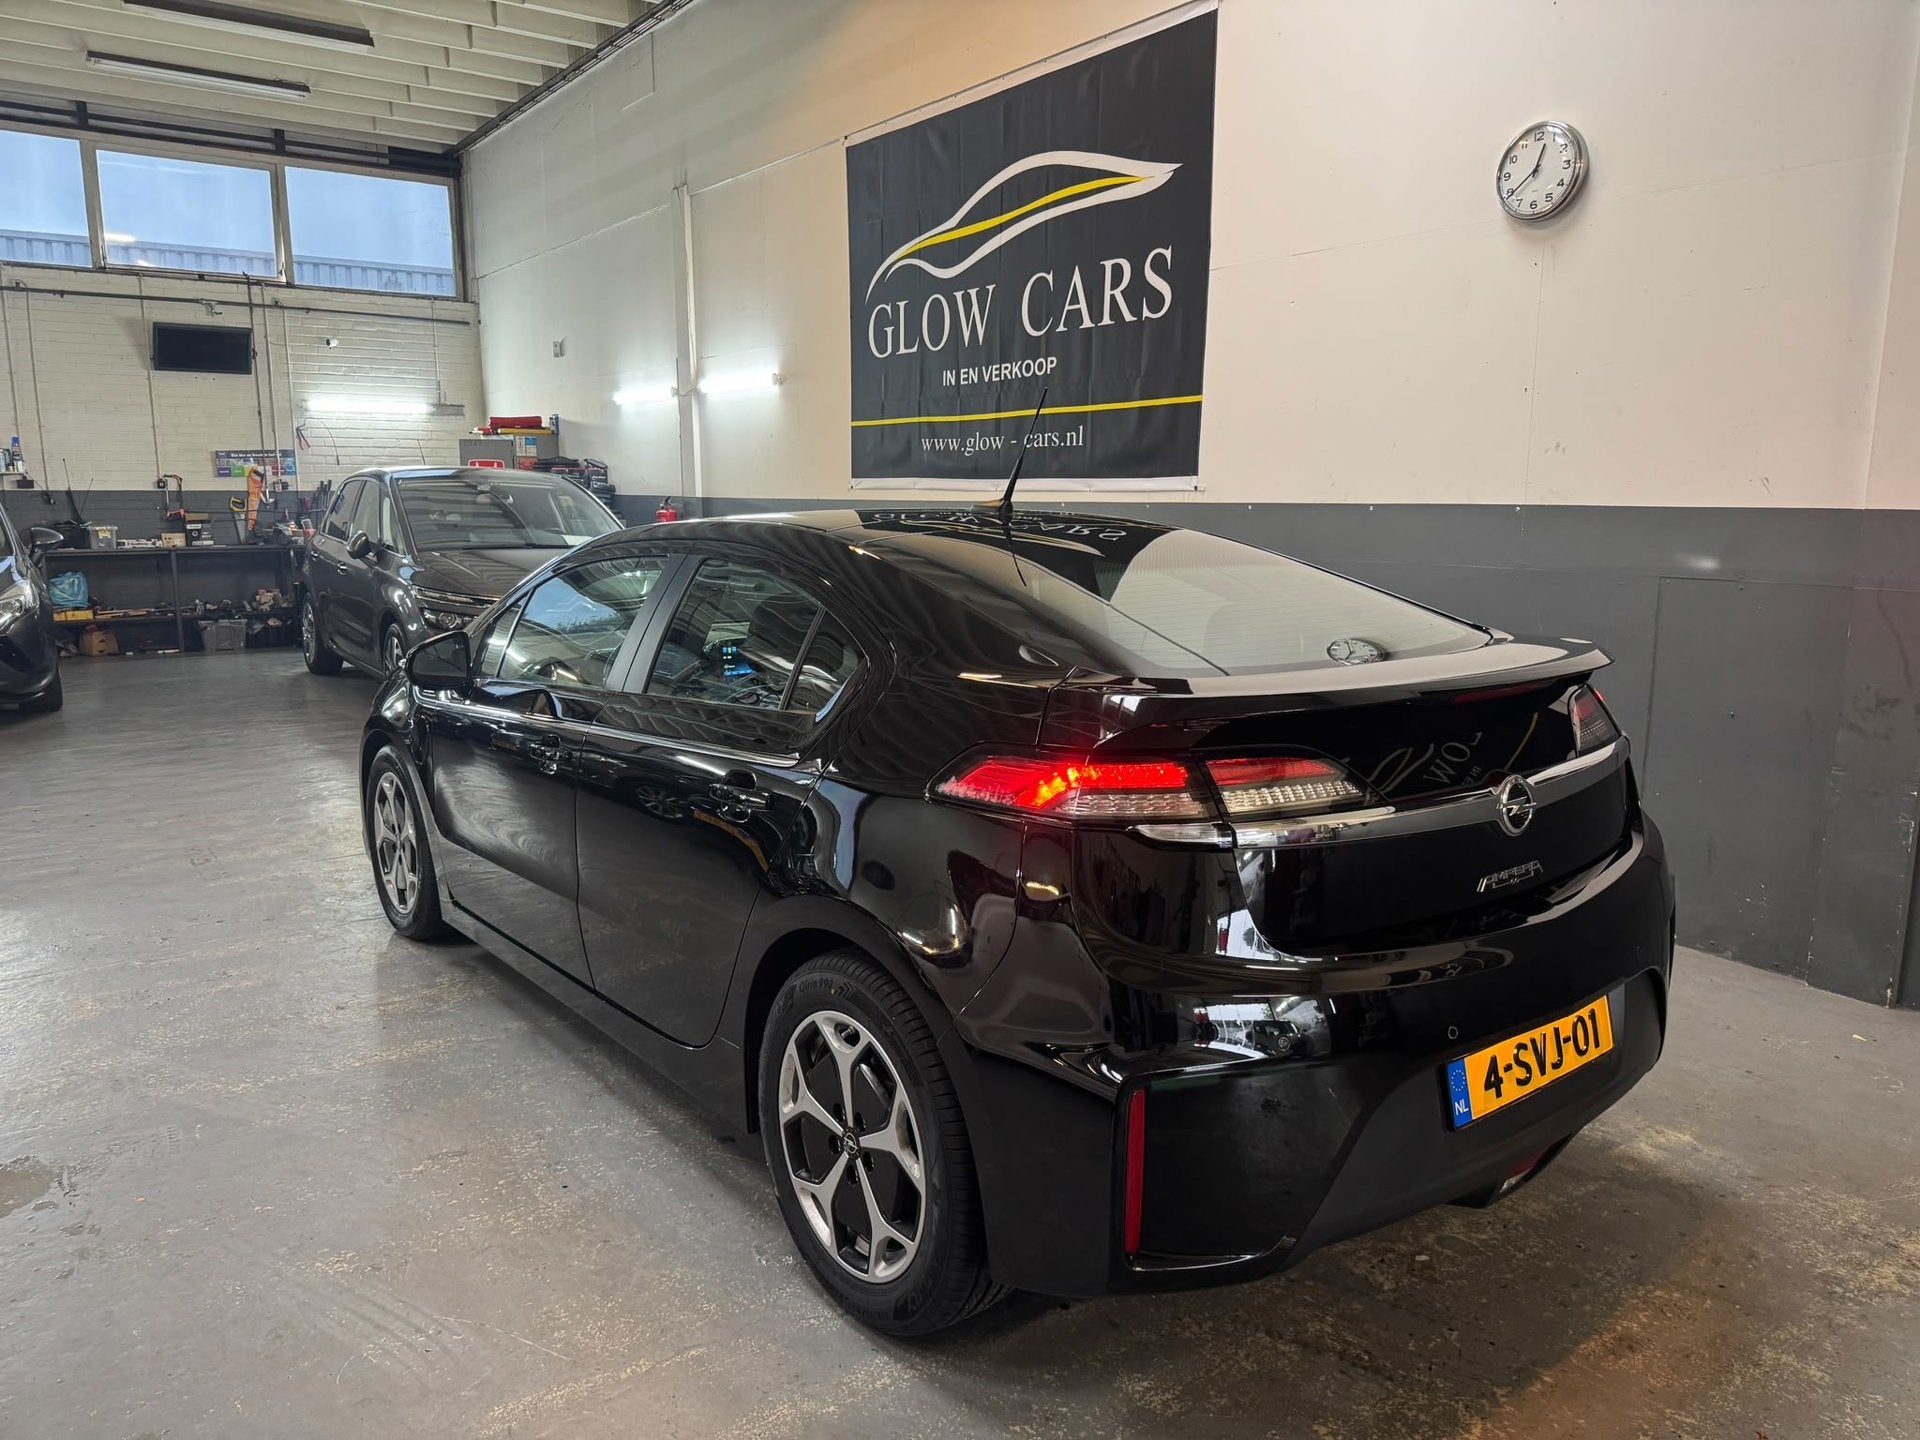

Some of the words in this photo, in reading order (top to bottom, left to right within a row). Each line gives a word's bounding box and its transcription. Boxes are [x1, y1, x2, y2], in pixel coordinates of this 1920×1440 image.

[1534, 131, 1545, 142] 12
[1509, 155, 1518, 164] 10
[1562, 159, 1571, 170] 3
[1503, 172, 1511, 181] 9
[1556, 178, 1565, 187] 4
[1516, 198, 1523, 208] 7
[1545, 193, 1554, 203] 5
[1529, 200, 1538, 209] 6
[868, 284, 997, 359] GLOW
[1021, 245, 1173, 337] CARS
[942, 369, 956, 386] IN
[960, 368, 979, 385] EN
[982, 356, 1057, 382] VERKOOP
[921, 432, 1005, 457] www.glow
[1023, 426, 1084, 449] cars.nl
[1484, 1008, 1600, 1100] 4-SVJ-01
[1454, 1099, 1469, 1116] NL
